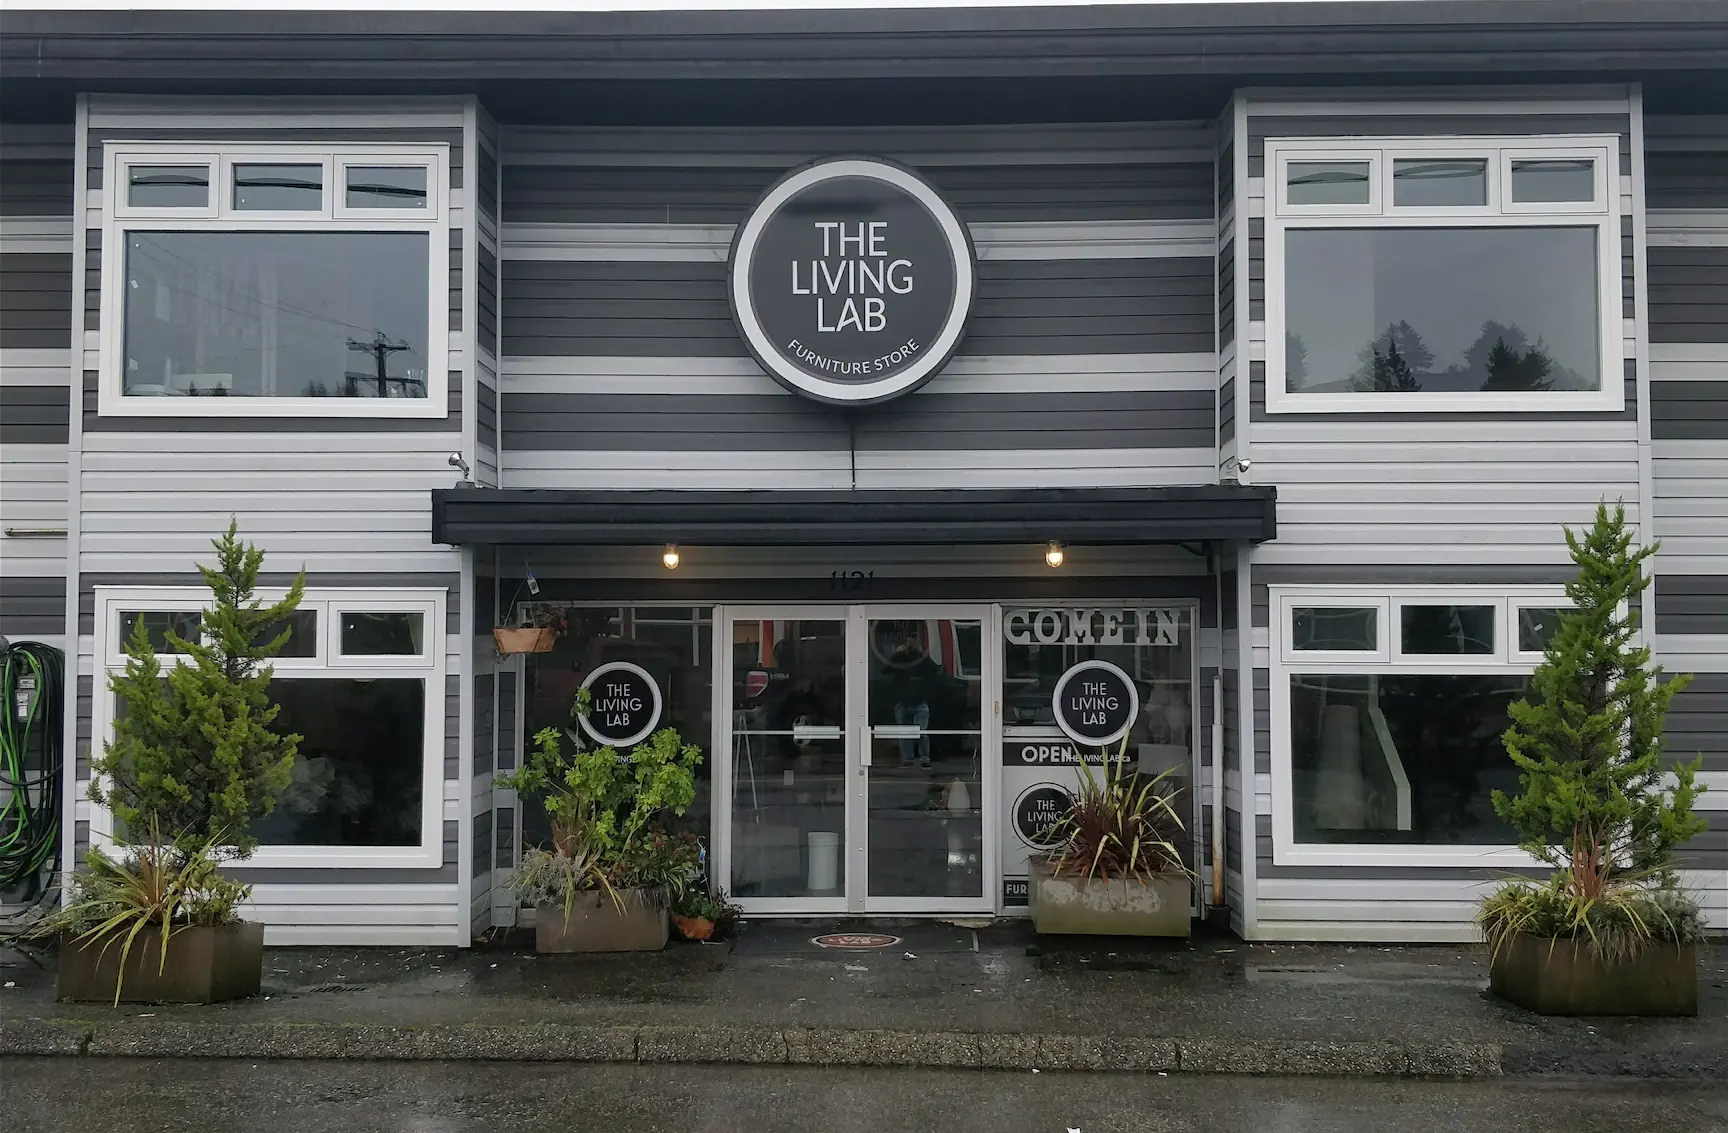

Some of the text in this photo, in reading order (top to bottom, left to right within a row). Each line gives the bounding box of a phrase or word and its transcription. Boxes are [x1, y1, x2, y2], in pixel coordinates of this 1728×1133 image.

[814, 221, 888, 257] THE
[791, 259, 914, 295] LIVING
[817, 297, 887, 332] LAB
[787, 338, 920, 375] FURNITURE STORE
[830, 570, 874, 592] 1121
[1003, 607, 1181, 646] COME IN
[606, 683, 631, 697] THE
[1082, 682, 1107, 696] THE
[596, 697, 643, 712] LIVING
[1071, 697, 1119, 711] LIVING
[606, 712, 630, 727] LAB
[1082, 712, 1107, 725] LAB
[1021, 745, 1072, 763] OPEN
[1036, 799, 1056, 811] THE
